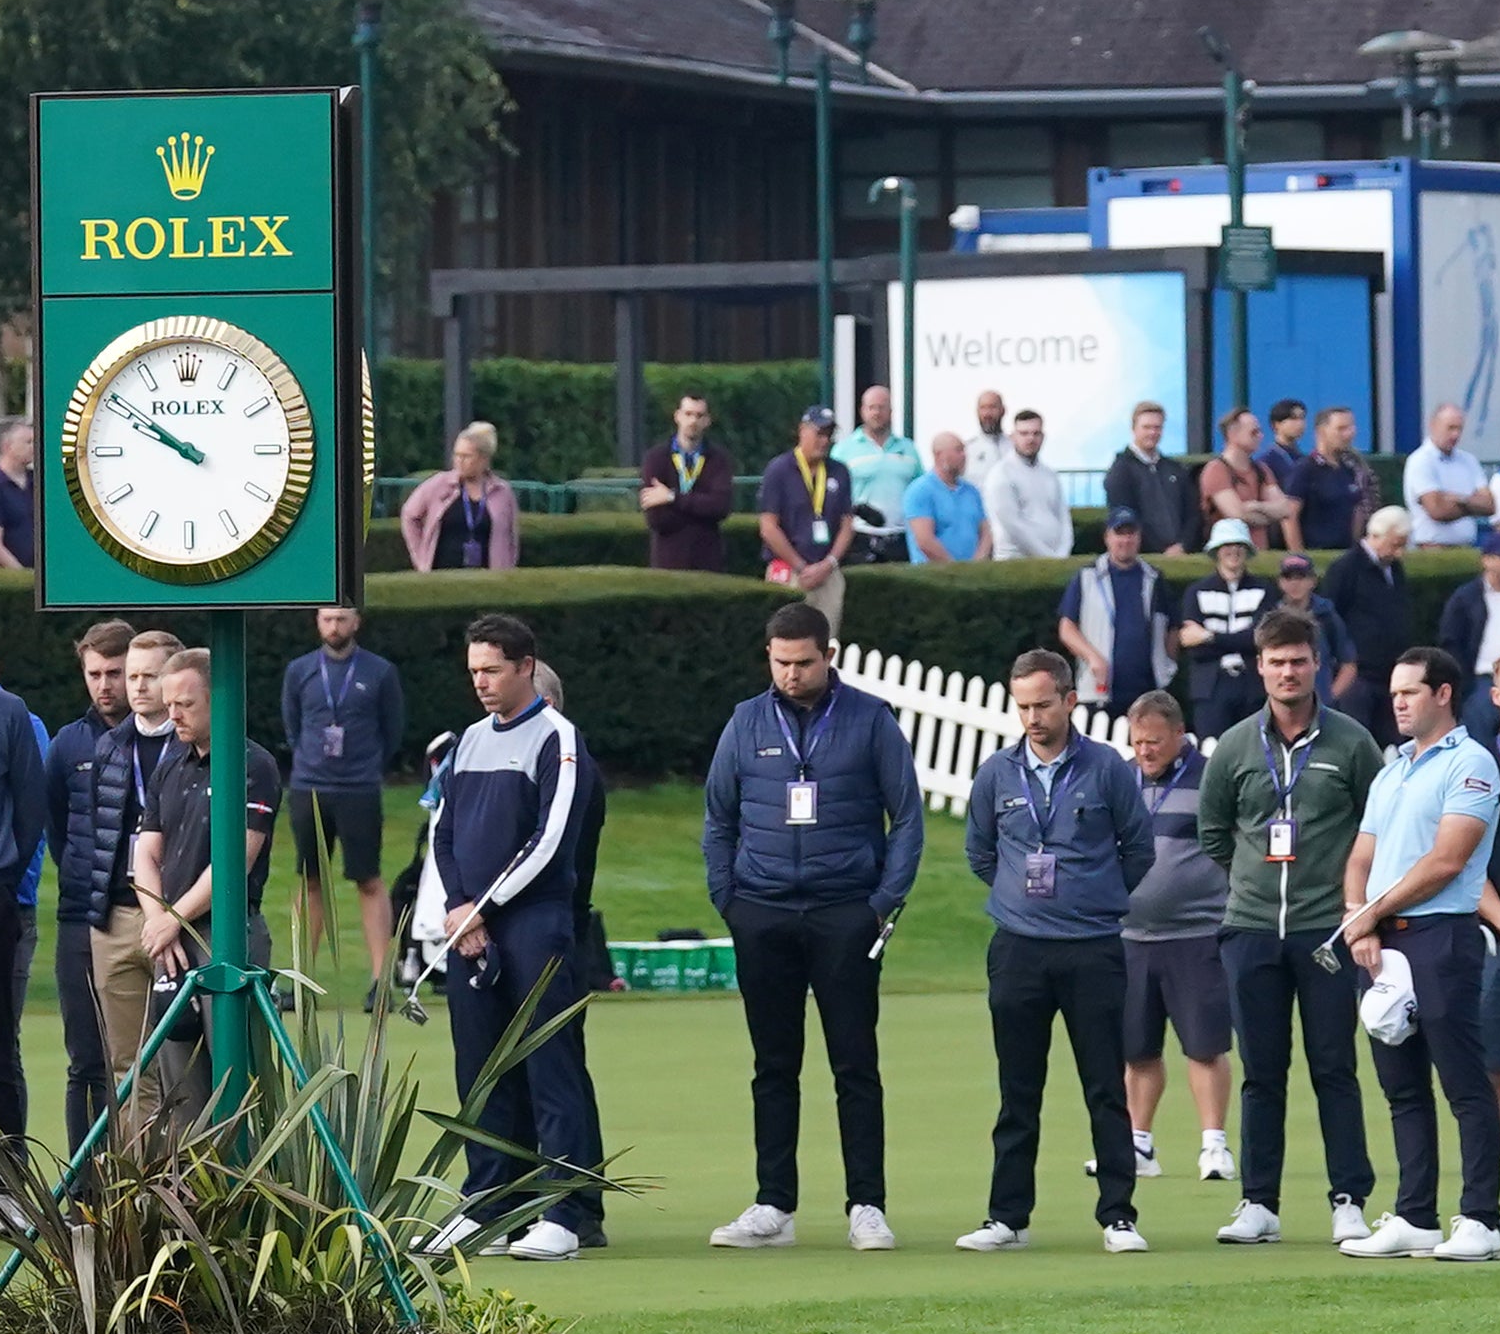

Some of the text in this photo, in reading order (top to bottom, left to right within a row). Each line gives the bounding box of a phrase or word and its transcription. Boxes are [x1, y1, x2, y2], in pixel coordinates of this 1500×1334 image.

[80, 216, 293, 260] ROLEX
[926, 332, 1098, 367] Welcome
[151, 399, 225, 415] ROLEX
